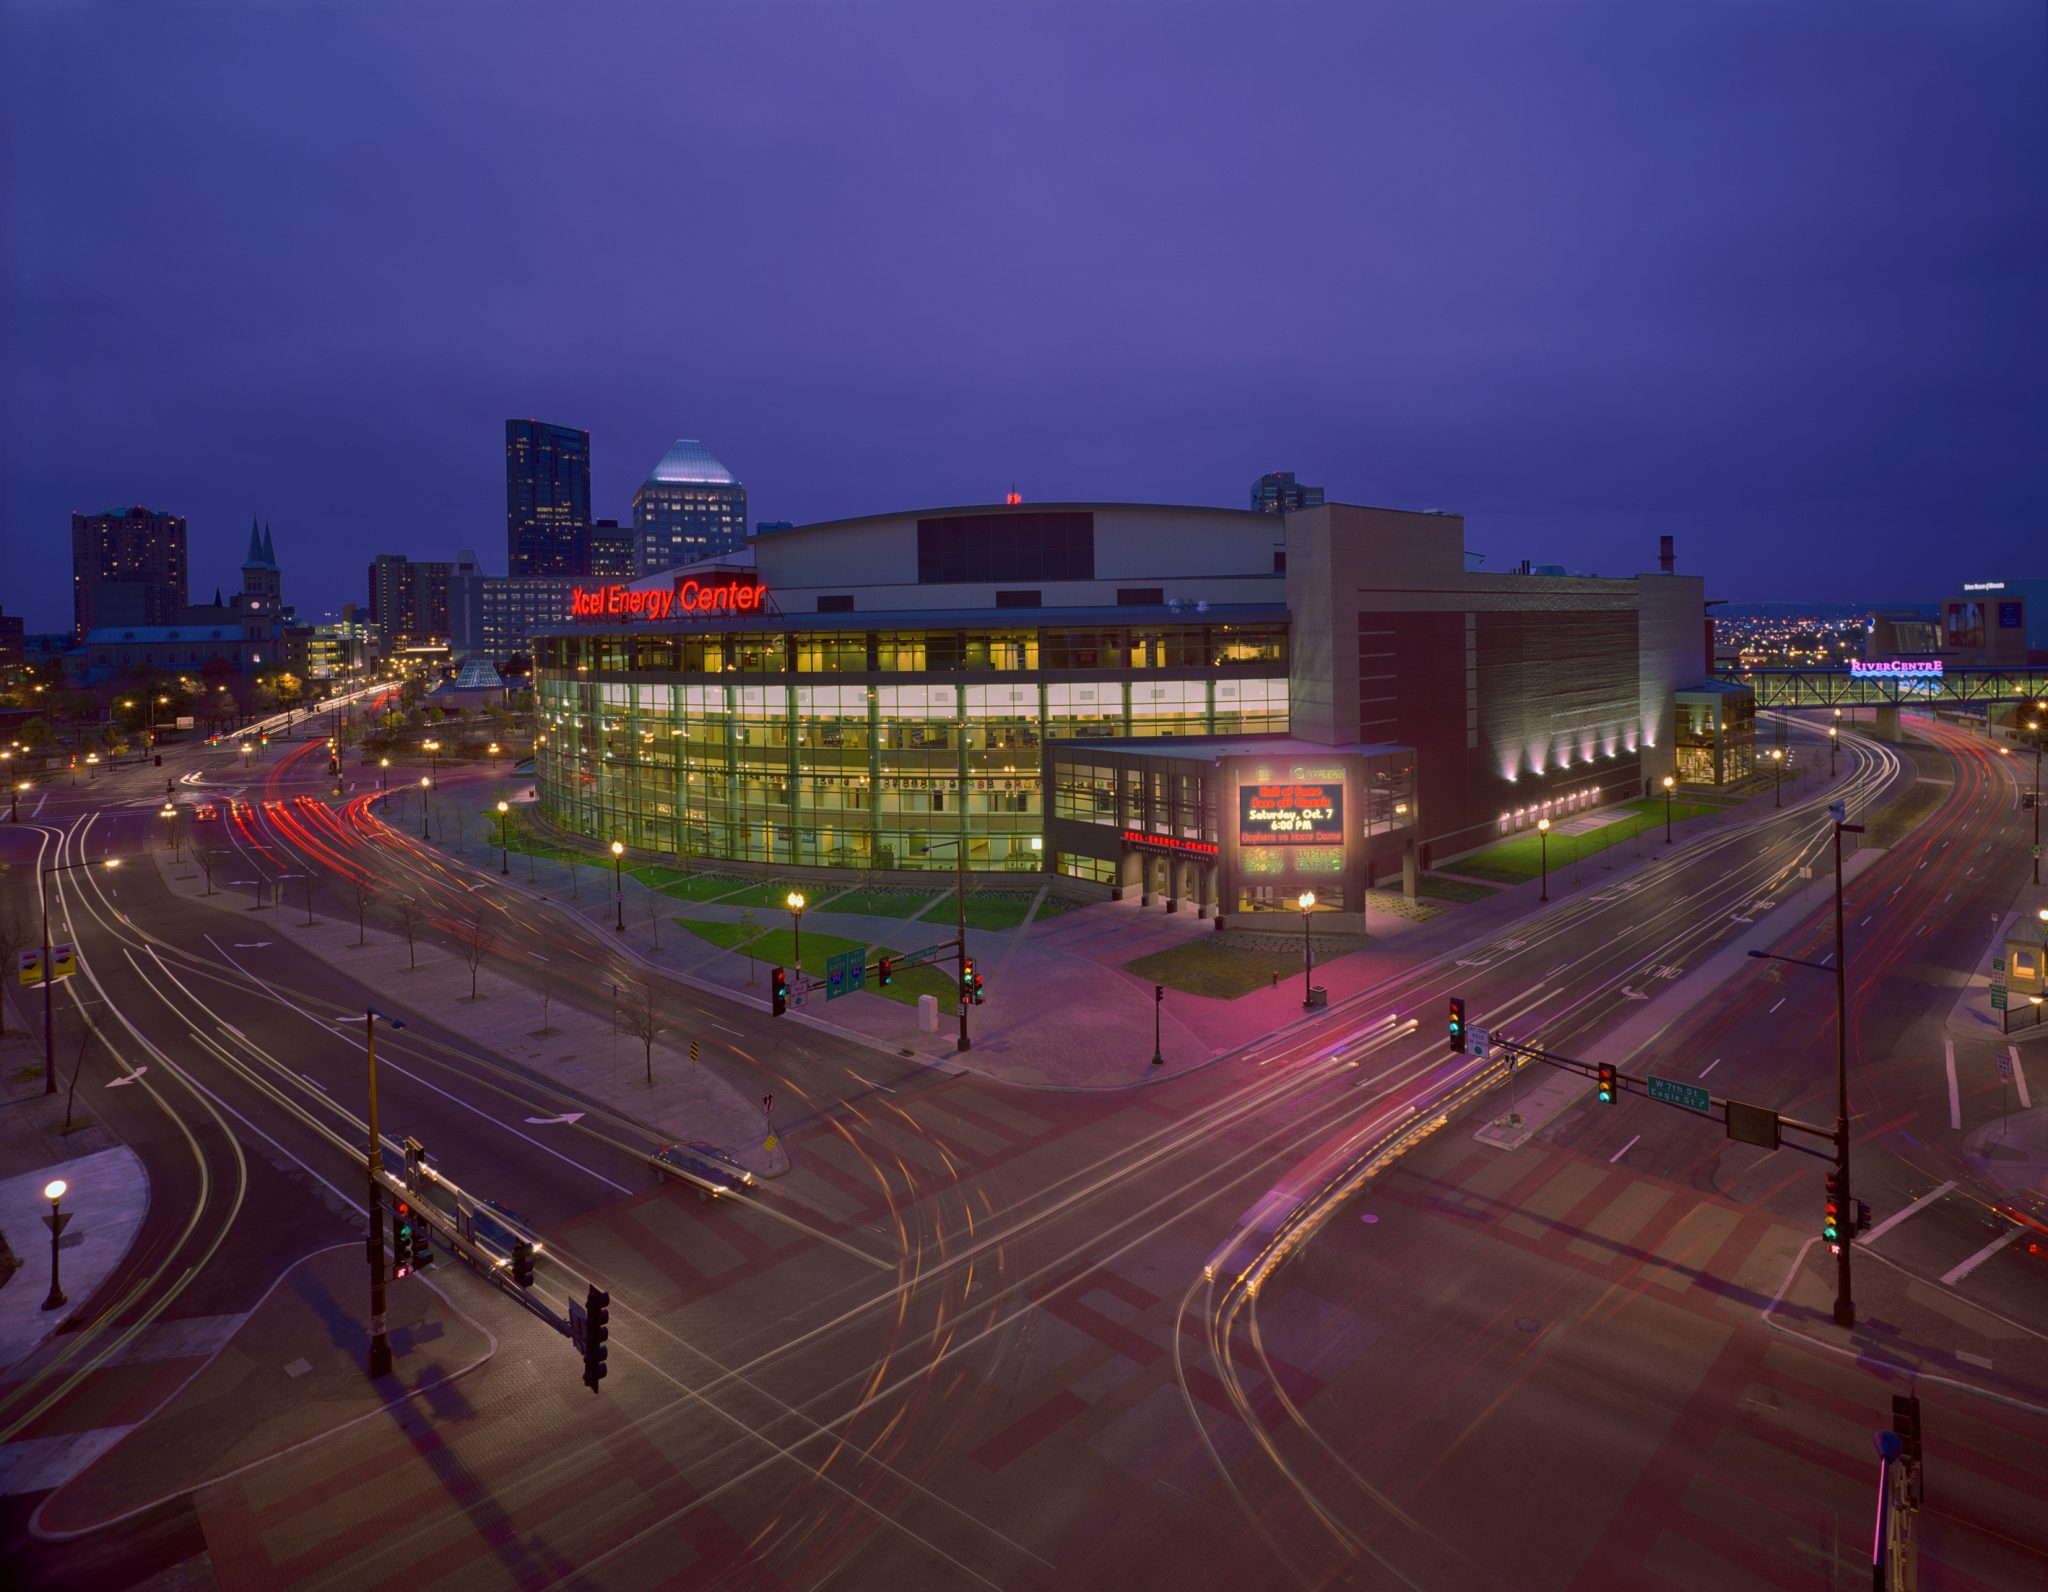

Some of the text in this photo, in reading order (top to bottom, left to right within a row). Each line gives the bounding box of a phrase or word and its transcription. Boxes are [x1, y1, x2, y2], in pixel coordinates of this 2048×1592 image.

[573, 580, 766, 620] Xcel Energy Center
[1260, 786, 1322, 797] Hall of Fame
[1249, 809, 1333, 822] Saturday, Oct. 7
[1271, 820, 1313, 831] 6:00 PM
[1316, 832, 1342, 841] Dame
[1656, 1080, 1698, 1097] W 7th St
[1651, 1088, 1695, 1106] Eagle St
